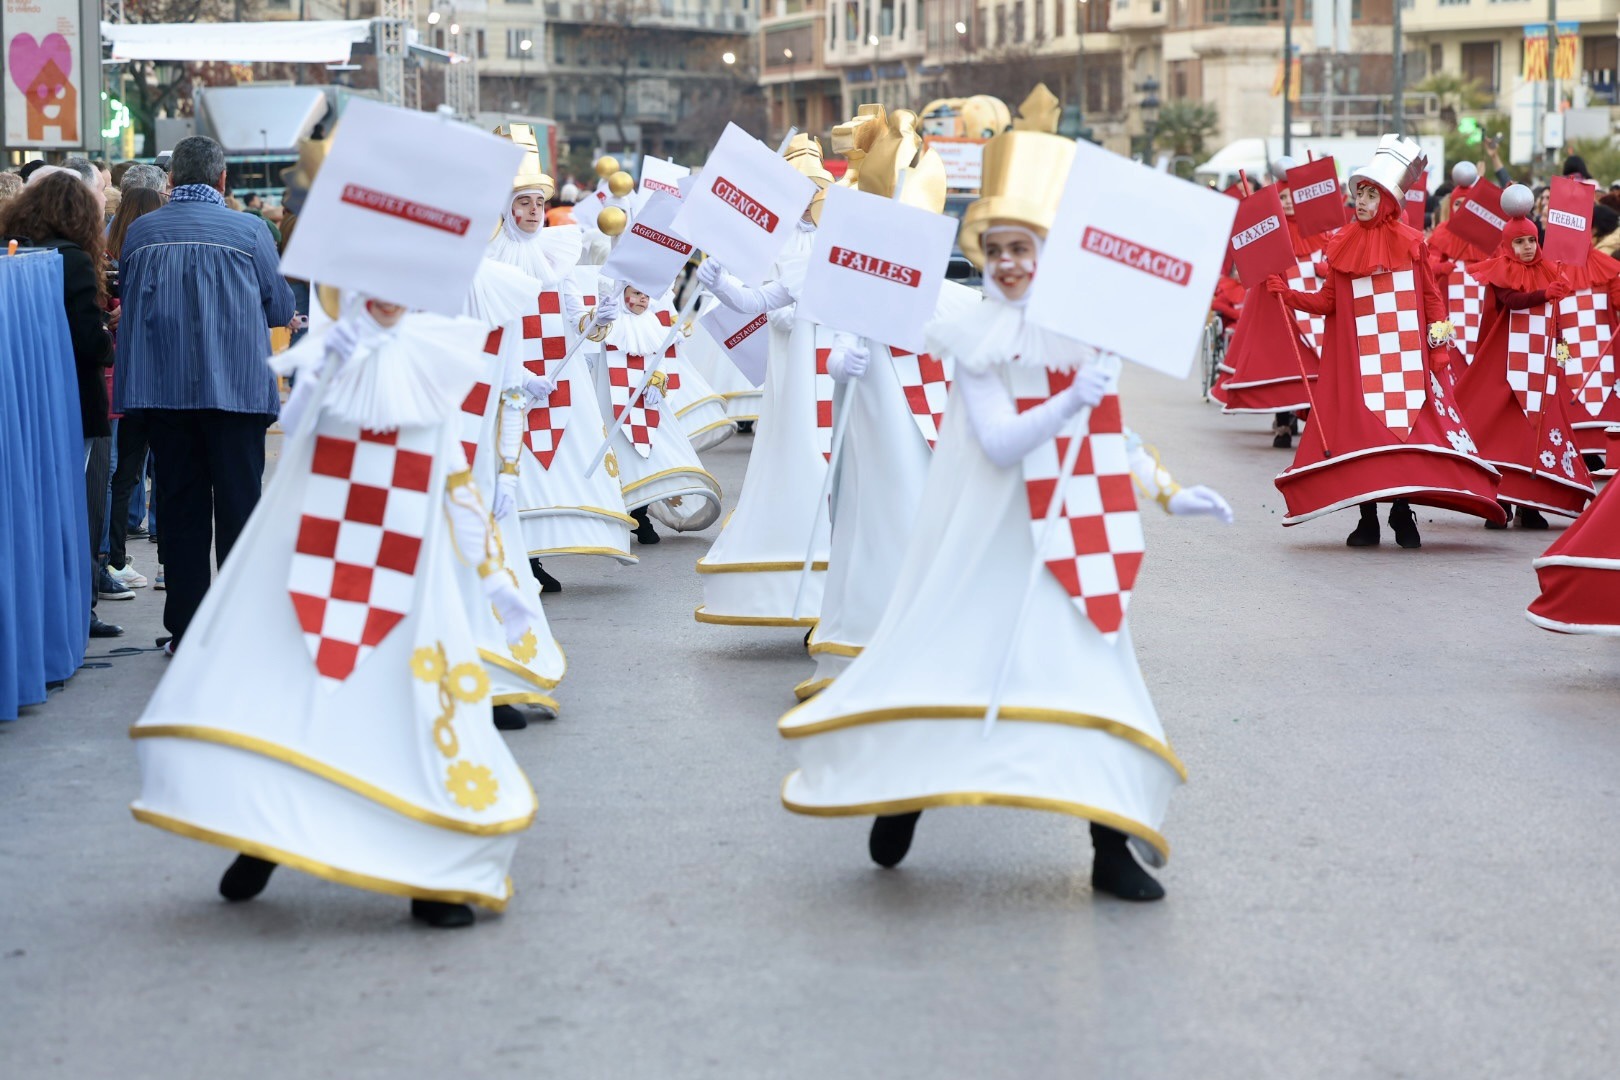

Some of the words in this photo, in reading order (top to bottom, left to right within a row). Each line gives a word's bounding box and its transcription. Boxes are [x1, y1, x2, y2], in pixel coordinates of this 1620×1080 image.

[1297, 180, 1334, 201] PREUS
[715, 181, 770, 229] CIÈNCIA
[1235, 218, 1276, 246] TAXES
[1550, 211, 1585, 230] TREBALL
[632, 224, 687, 253] AGRICULTURA
[835, 248, 912, 284] FALLES
